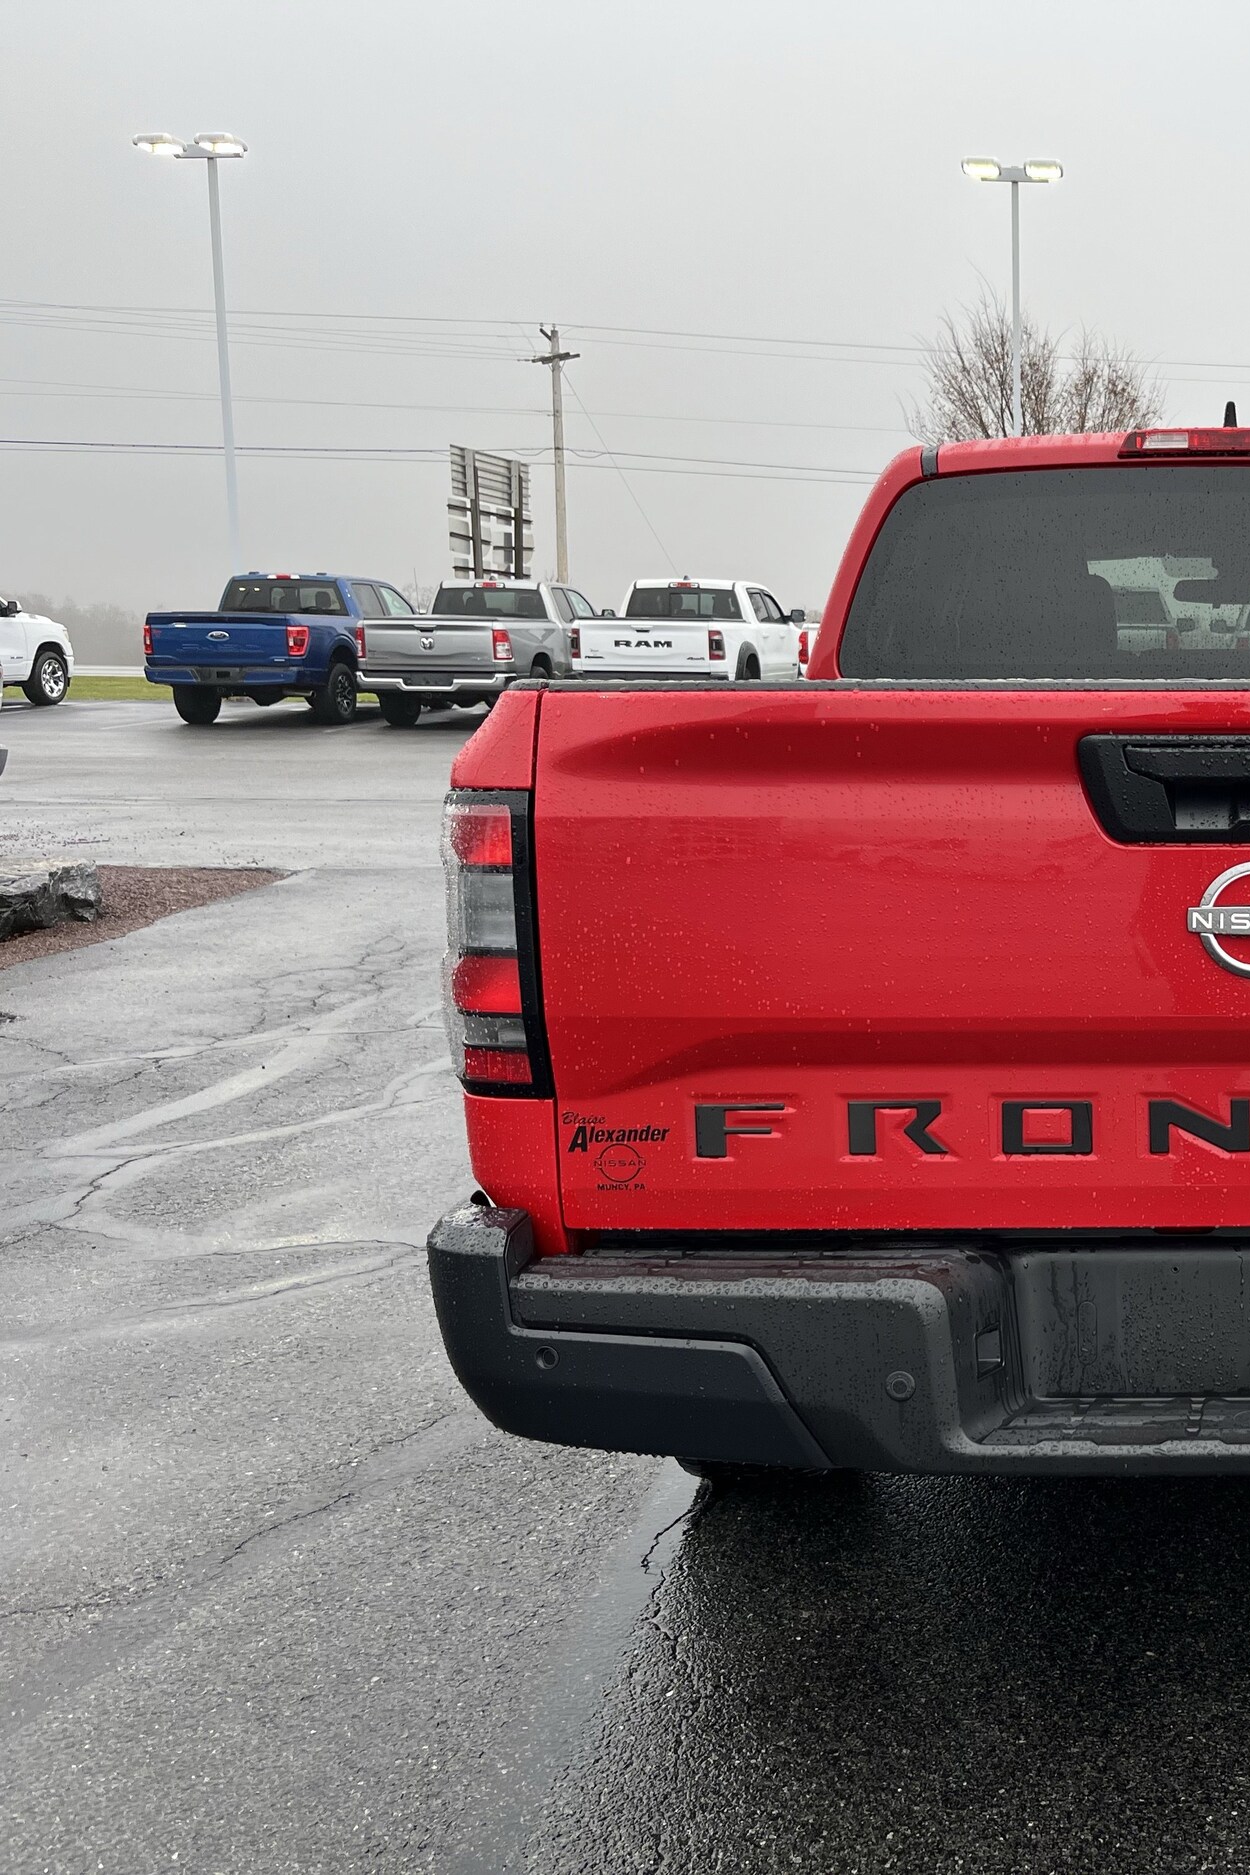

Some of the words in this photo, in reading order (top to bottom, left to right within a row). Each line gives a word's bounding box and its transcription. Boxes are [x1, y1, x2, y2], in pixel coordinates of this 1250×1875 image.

[614, 640, 673, 648] RAM
[561, 1111, 606, 1125] Blaise
[567, 1125, 670, 1153] Alexander
[593, 1159, 647, 1168] NISSAN
[597, 1183, 632, 1192] MUNCY,
[634, 1183, 646, 1191] PA
